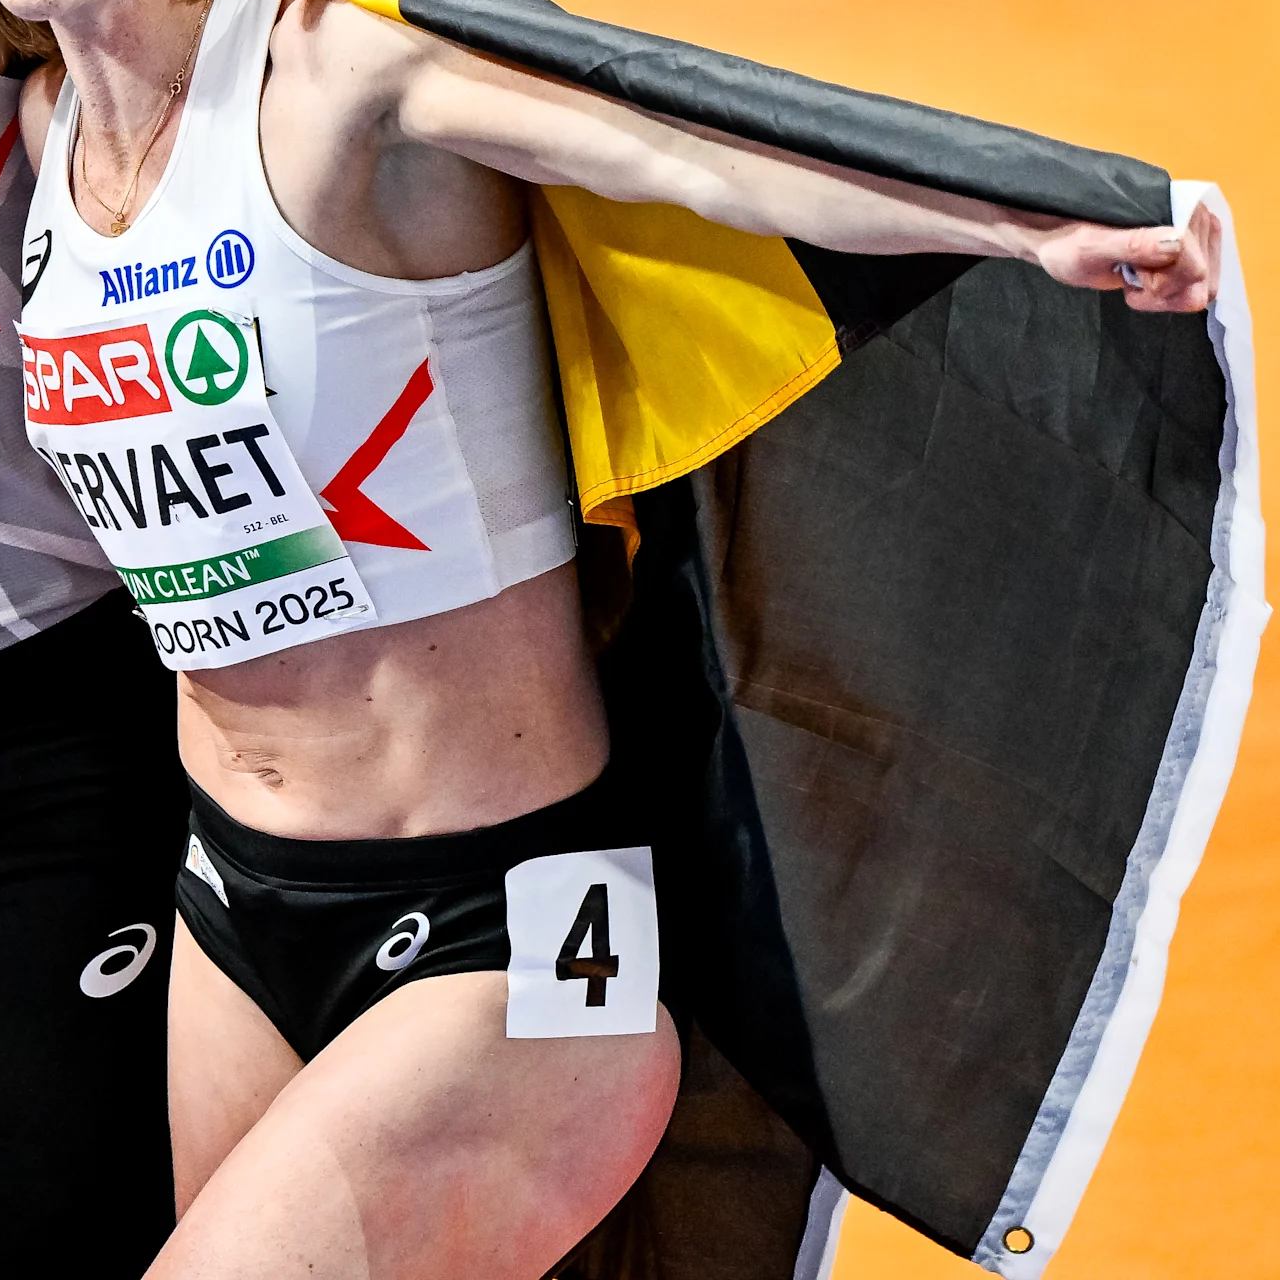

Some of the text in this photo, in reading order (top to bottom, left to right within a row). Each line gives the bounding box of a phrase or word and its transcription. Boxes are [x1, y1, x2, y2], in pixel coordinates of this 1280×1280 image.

[99, 255, 198, 307] Allianz
[21, 338, 162, 413] SPAR
[243, 521, 263, 534] 512
[270, 513, 289, 526] BEL
[254, 577, 355, 636] 2025
[555, 883, 619, 1007] 4
